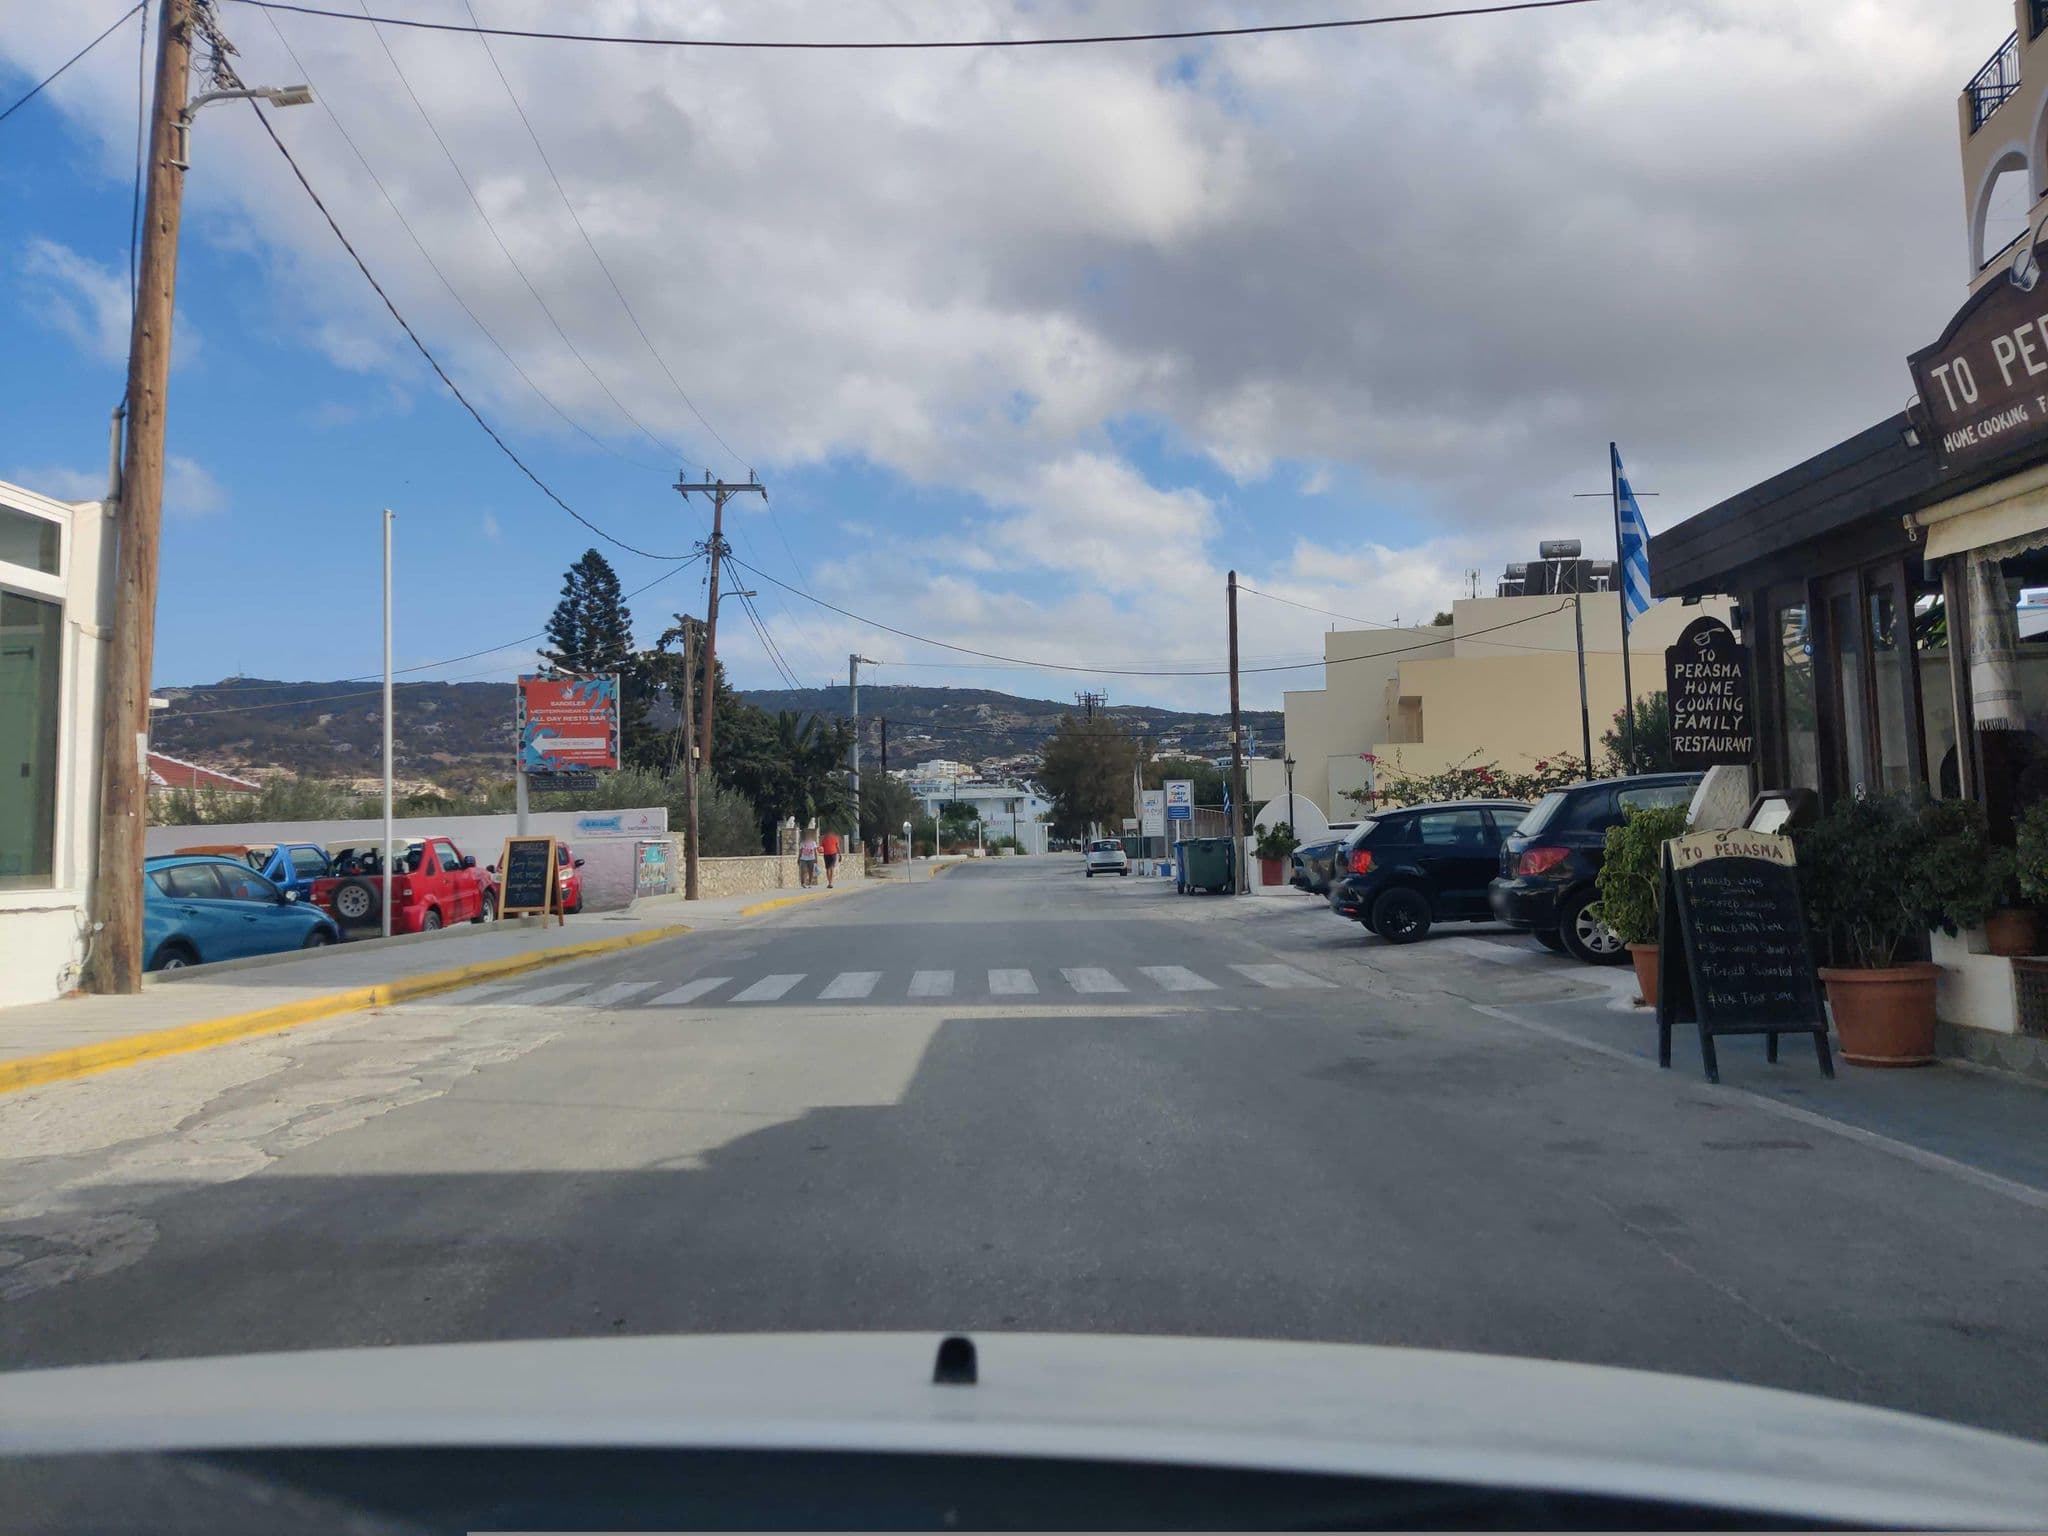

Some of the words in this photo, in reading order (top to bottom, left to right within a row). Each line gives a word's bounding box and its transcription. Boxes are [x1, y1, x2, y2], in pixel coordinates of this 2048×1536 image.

[1931, 357, 1978, 412] TO
[1943, 425, 1979, 453] HOME
[1977, 404, 2029, 438] COOKING
[2036, 395, 2048, 413] F
[1698, 649, 1716, 662] TO
[1674, 664, 1742, 679] PERASMA
[1685, 681, 1734, 695] HOME
[1675, 697, 1744, 712] COOKING
[1674, 714, 1743, 730] FAMILY
[1672, 736, 1753, 752] RESTAURANT
[1682, 847, 1703, 860] TO
[1714, 843, 1784, 859] PERASMA
